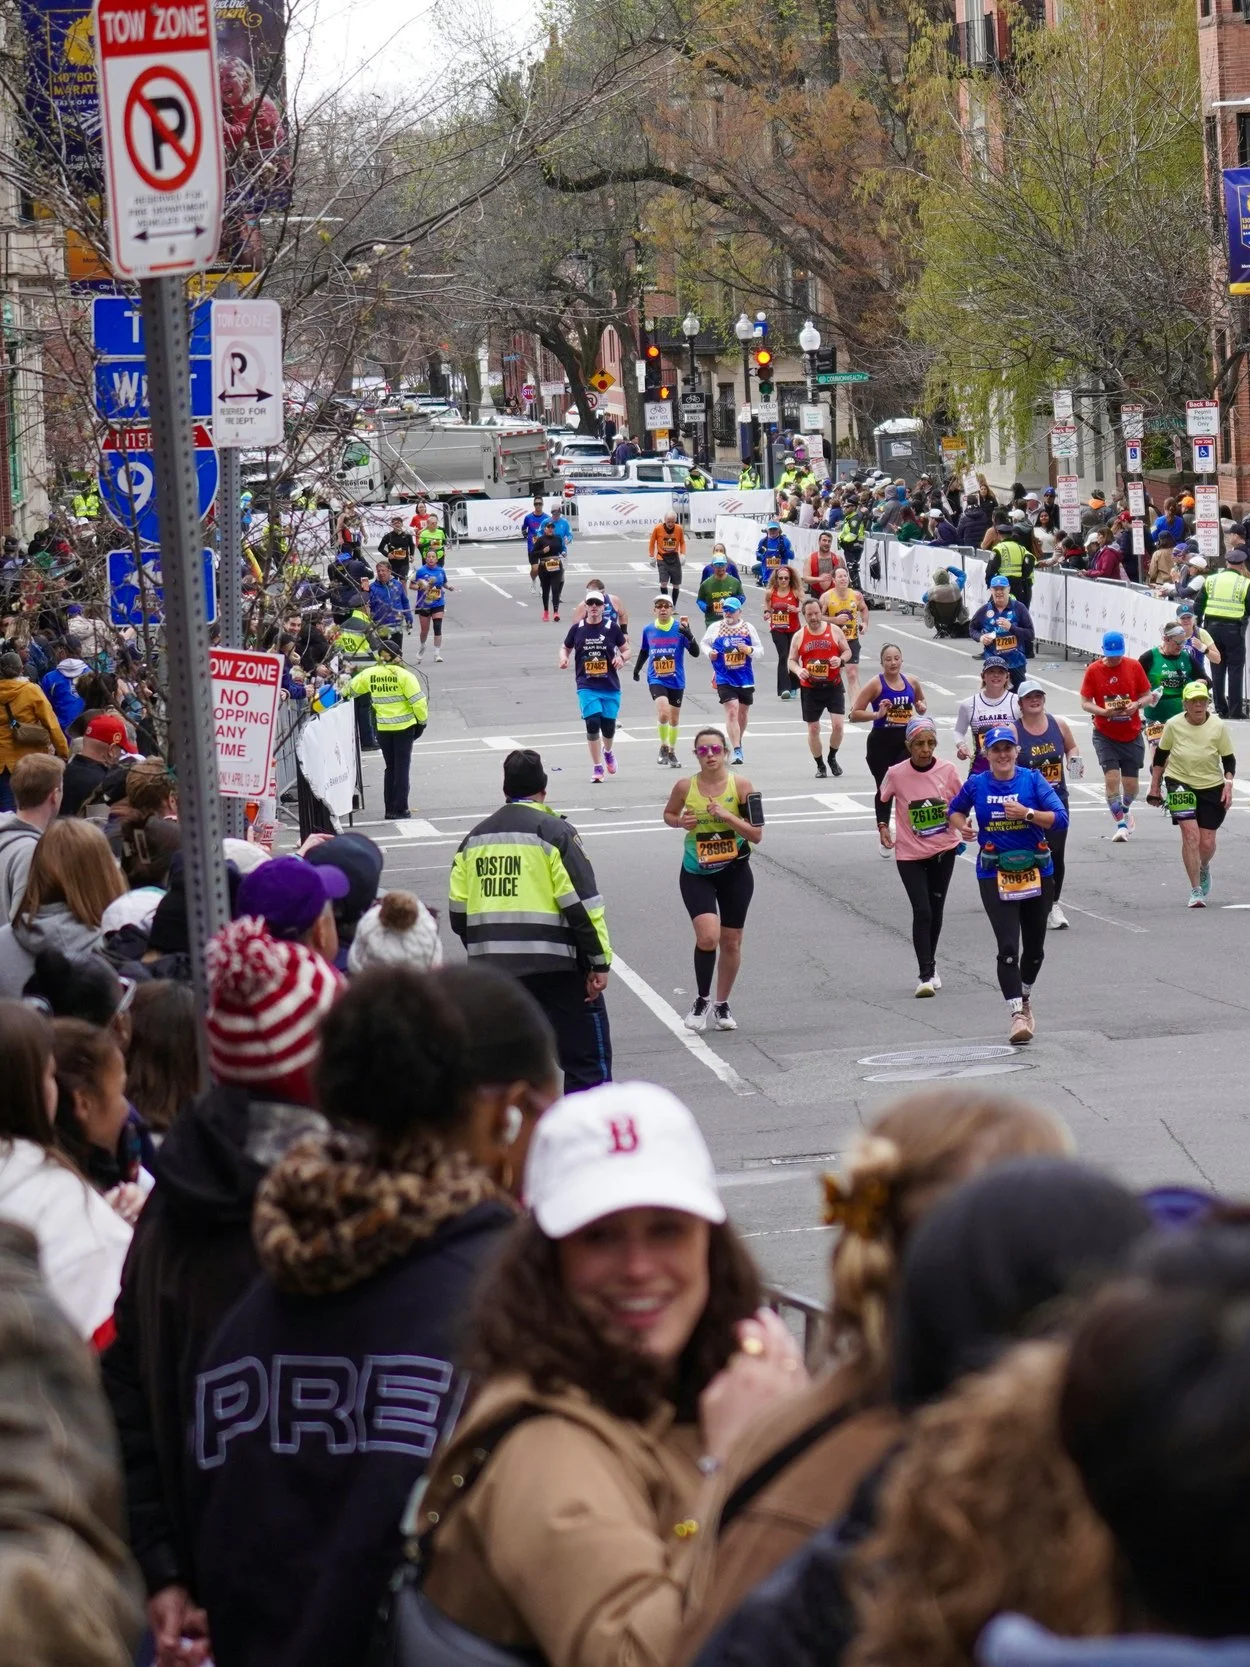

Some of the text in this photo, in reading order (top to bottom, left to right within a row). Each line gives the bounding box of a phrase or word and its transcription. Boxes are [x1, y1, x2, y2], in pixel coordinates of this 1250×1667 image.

[103, 7, 208, 44] TOW ZONE
[217, 312, 272, 328] TOW ZONE
[248, 407, 267, 416] FOR
[1205, 400, 1217, 408] Bay
[477, 525, 500, 533] BANK
[625, 518, 662, 526] AMERICA
[236, 660, 278, 682] ZONE
[370, 674, 398, 684] Boston
[370, 683, 399, 693] Police
[219, 688, 250, 707] NO
[213, 707, 270, 726] OPPING
[978, 713, 1008, 722] CLAIRE
[214, 724, 247, 740] ANY
[911, 806, 945, 825] 26135
[475, 855, 522, 878] BOSTON
[480, 876, 519, 898] POLICE
